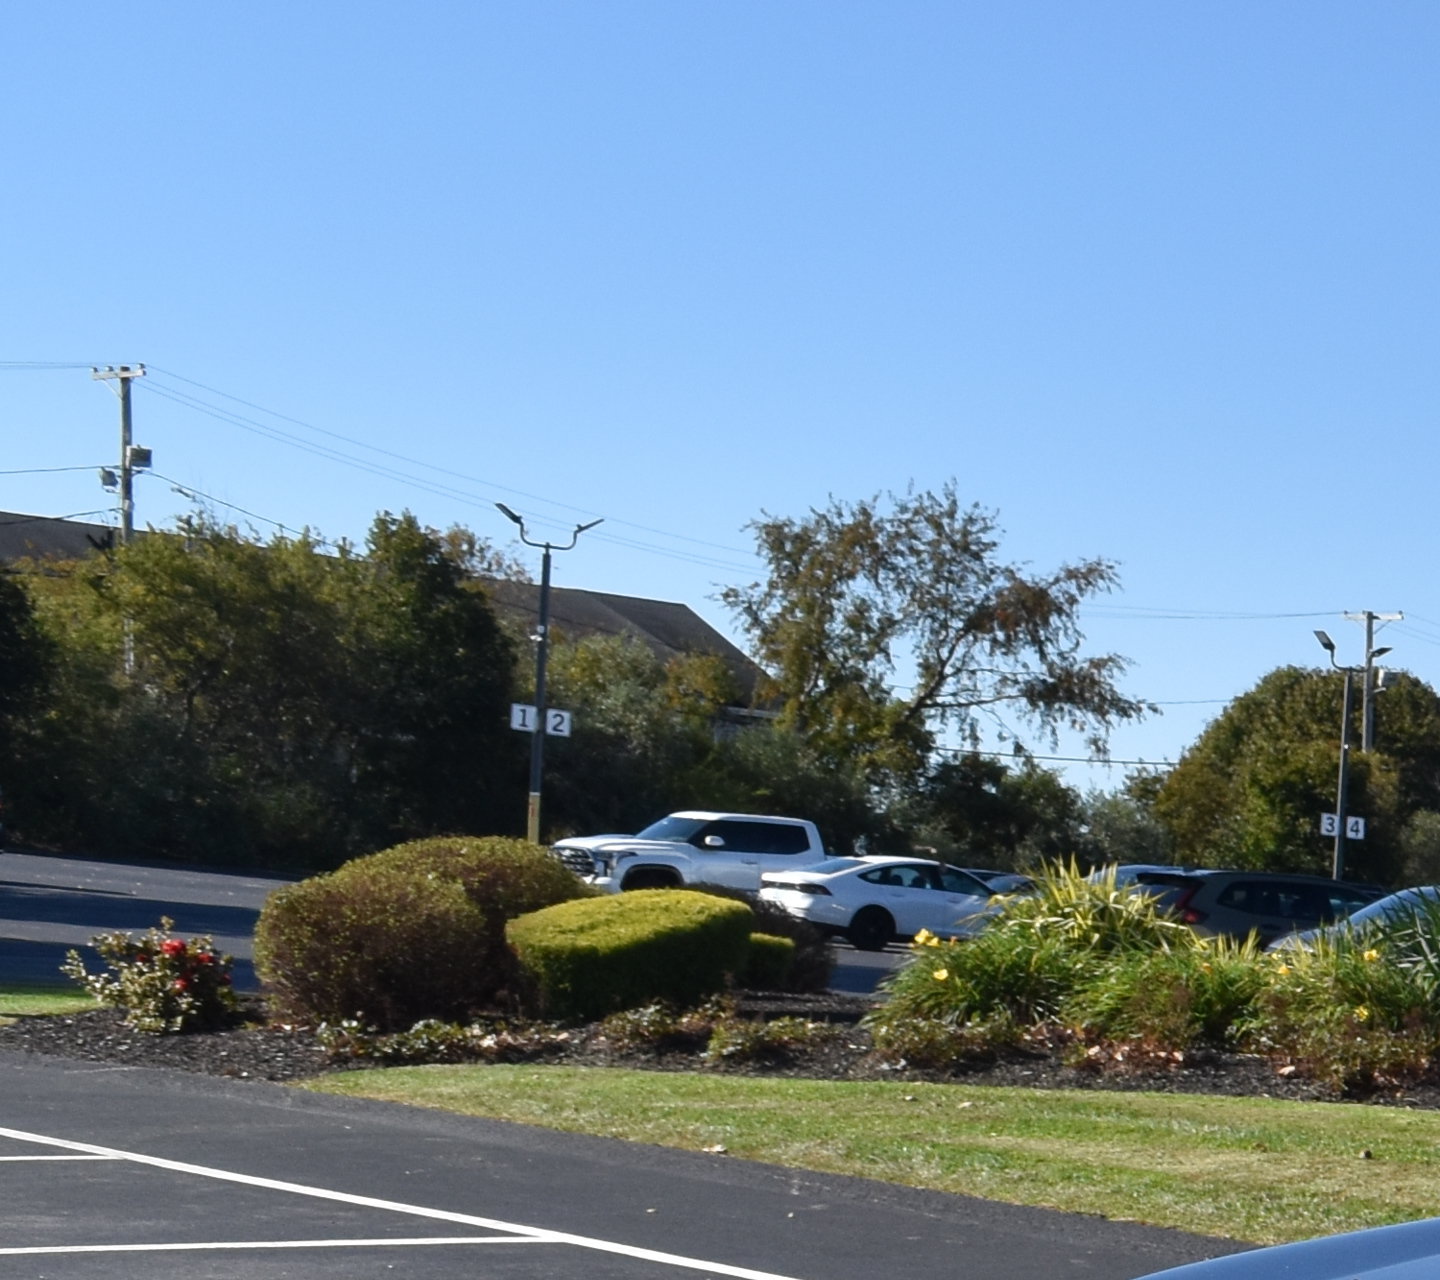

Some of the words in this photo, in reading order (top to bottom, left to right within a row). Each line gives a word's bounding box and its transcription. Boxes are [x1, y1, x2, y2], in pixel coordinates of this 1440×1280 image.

[519, 709, 528, 728] 1
[552, 713, 565, 732] 2
[1325, 817, 1335, 832] 3
[1351, 820, 1360, 836] 4
